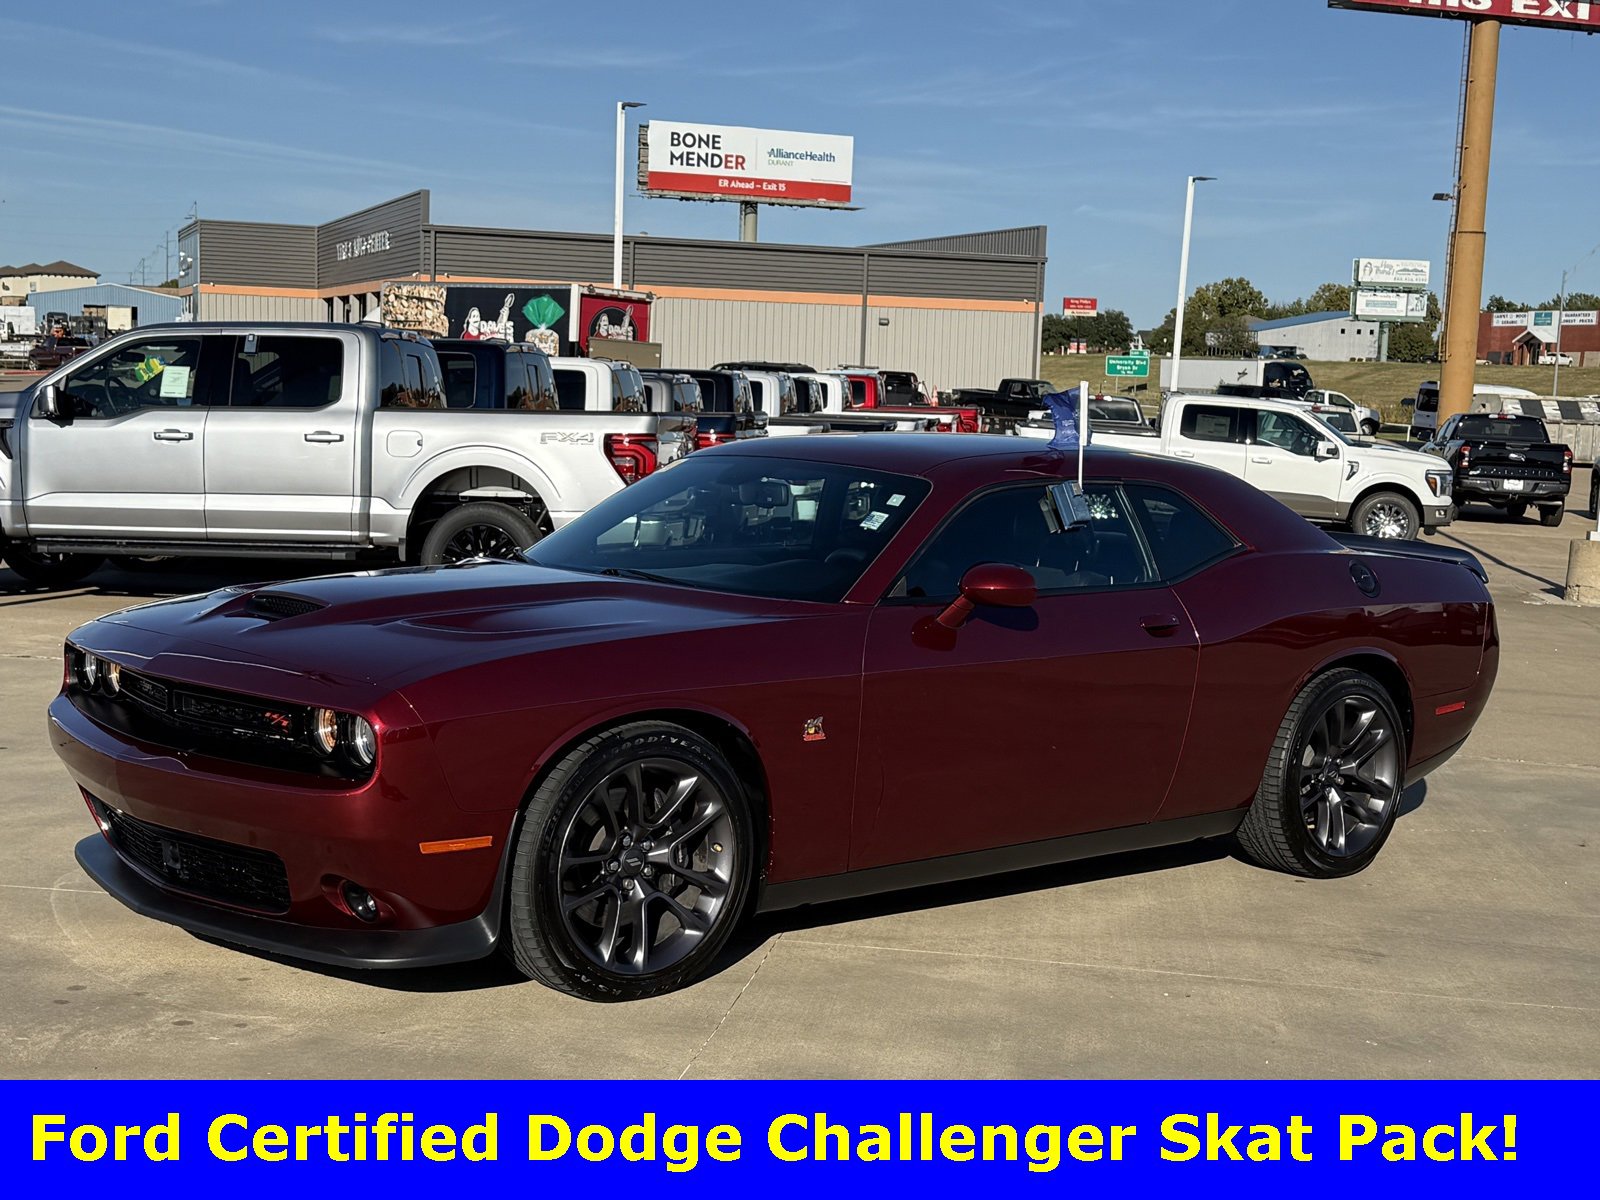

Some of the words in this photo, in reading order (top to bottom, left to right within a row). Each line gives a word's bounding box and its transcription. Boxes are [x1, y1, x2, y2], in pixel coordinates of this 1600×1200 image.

[669, 131, 722, 150] BONE
[669, 150, 746, 171] MENDER
[767, 147, 836, 162] AllianceHealth
[768, 158, 794, 167] DURANT
[718, 178, 729, 188] ER
[730, 179, 755, 189] Ahead
[762, 182, 778, 191] Exit
[778, 182, 787, 192] 15
[540, 431, 595, 445] FX4
